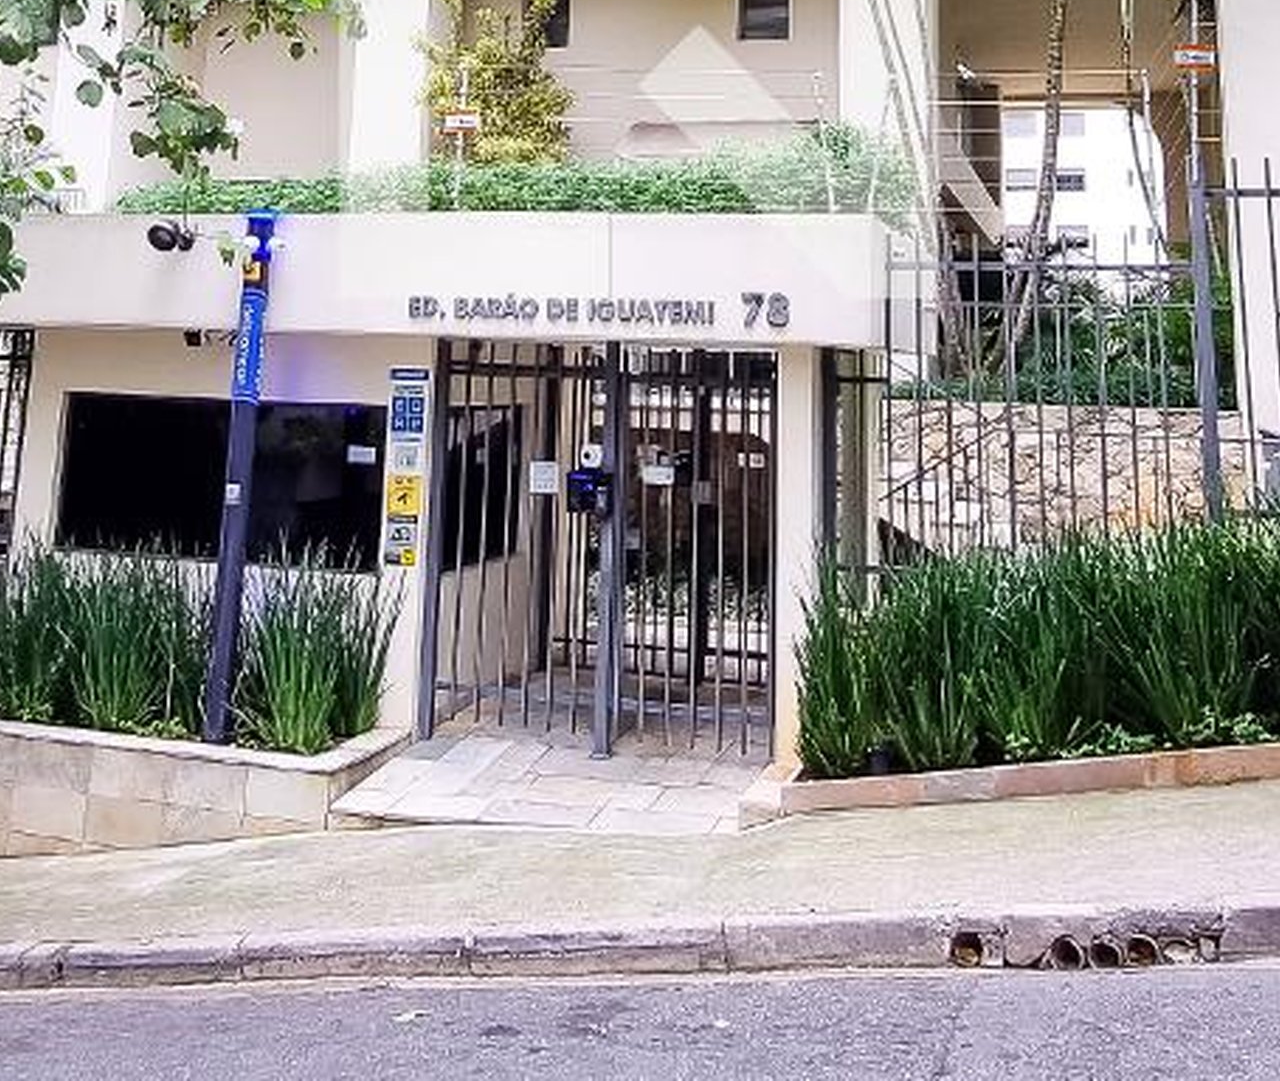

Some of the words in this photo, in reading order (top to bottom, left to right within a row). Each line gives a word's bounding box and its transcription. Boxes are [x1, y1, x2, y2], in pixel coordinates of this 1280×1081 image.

[408, 296, 446, 320] ED.
[454, 292, 540, 321] BARÃO
[547, 297, 579, 322] DE
[587, 297, 716, 325] IGUATEMI
[740, 292, 791, 328] 78
